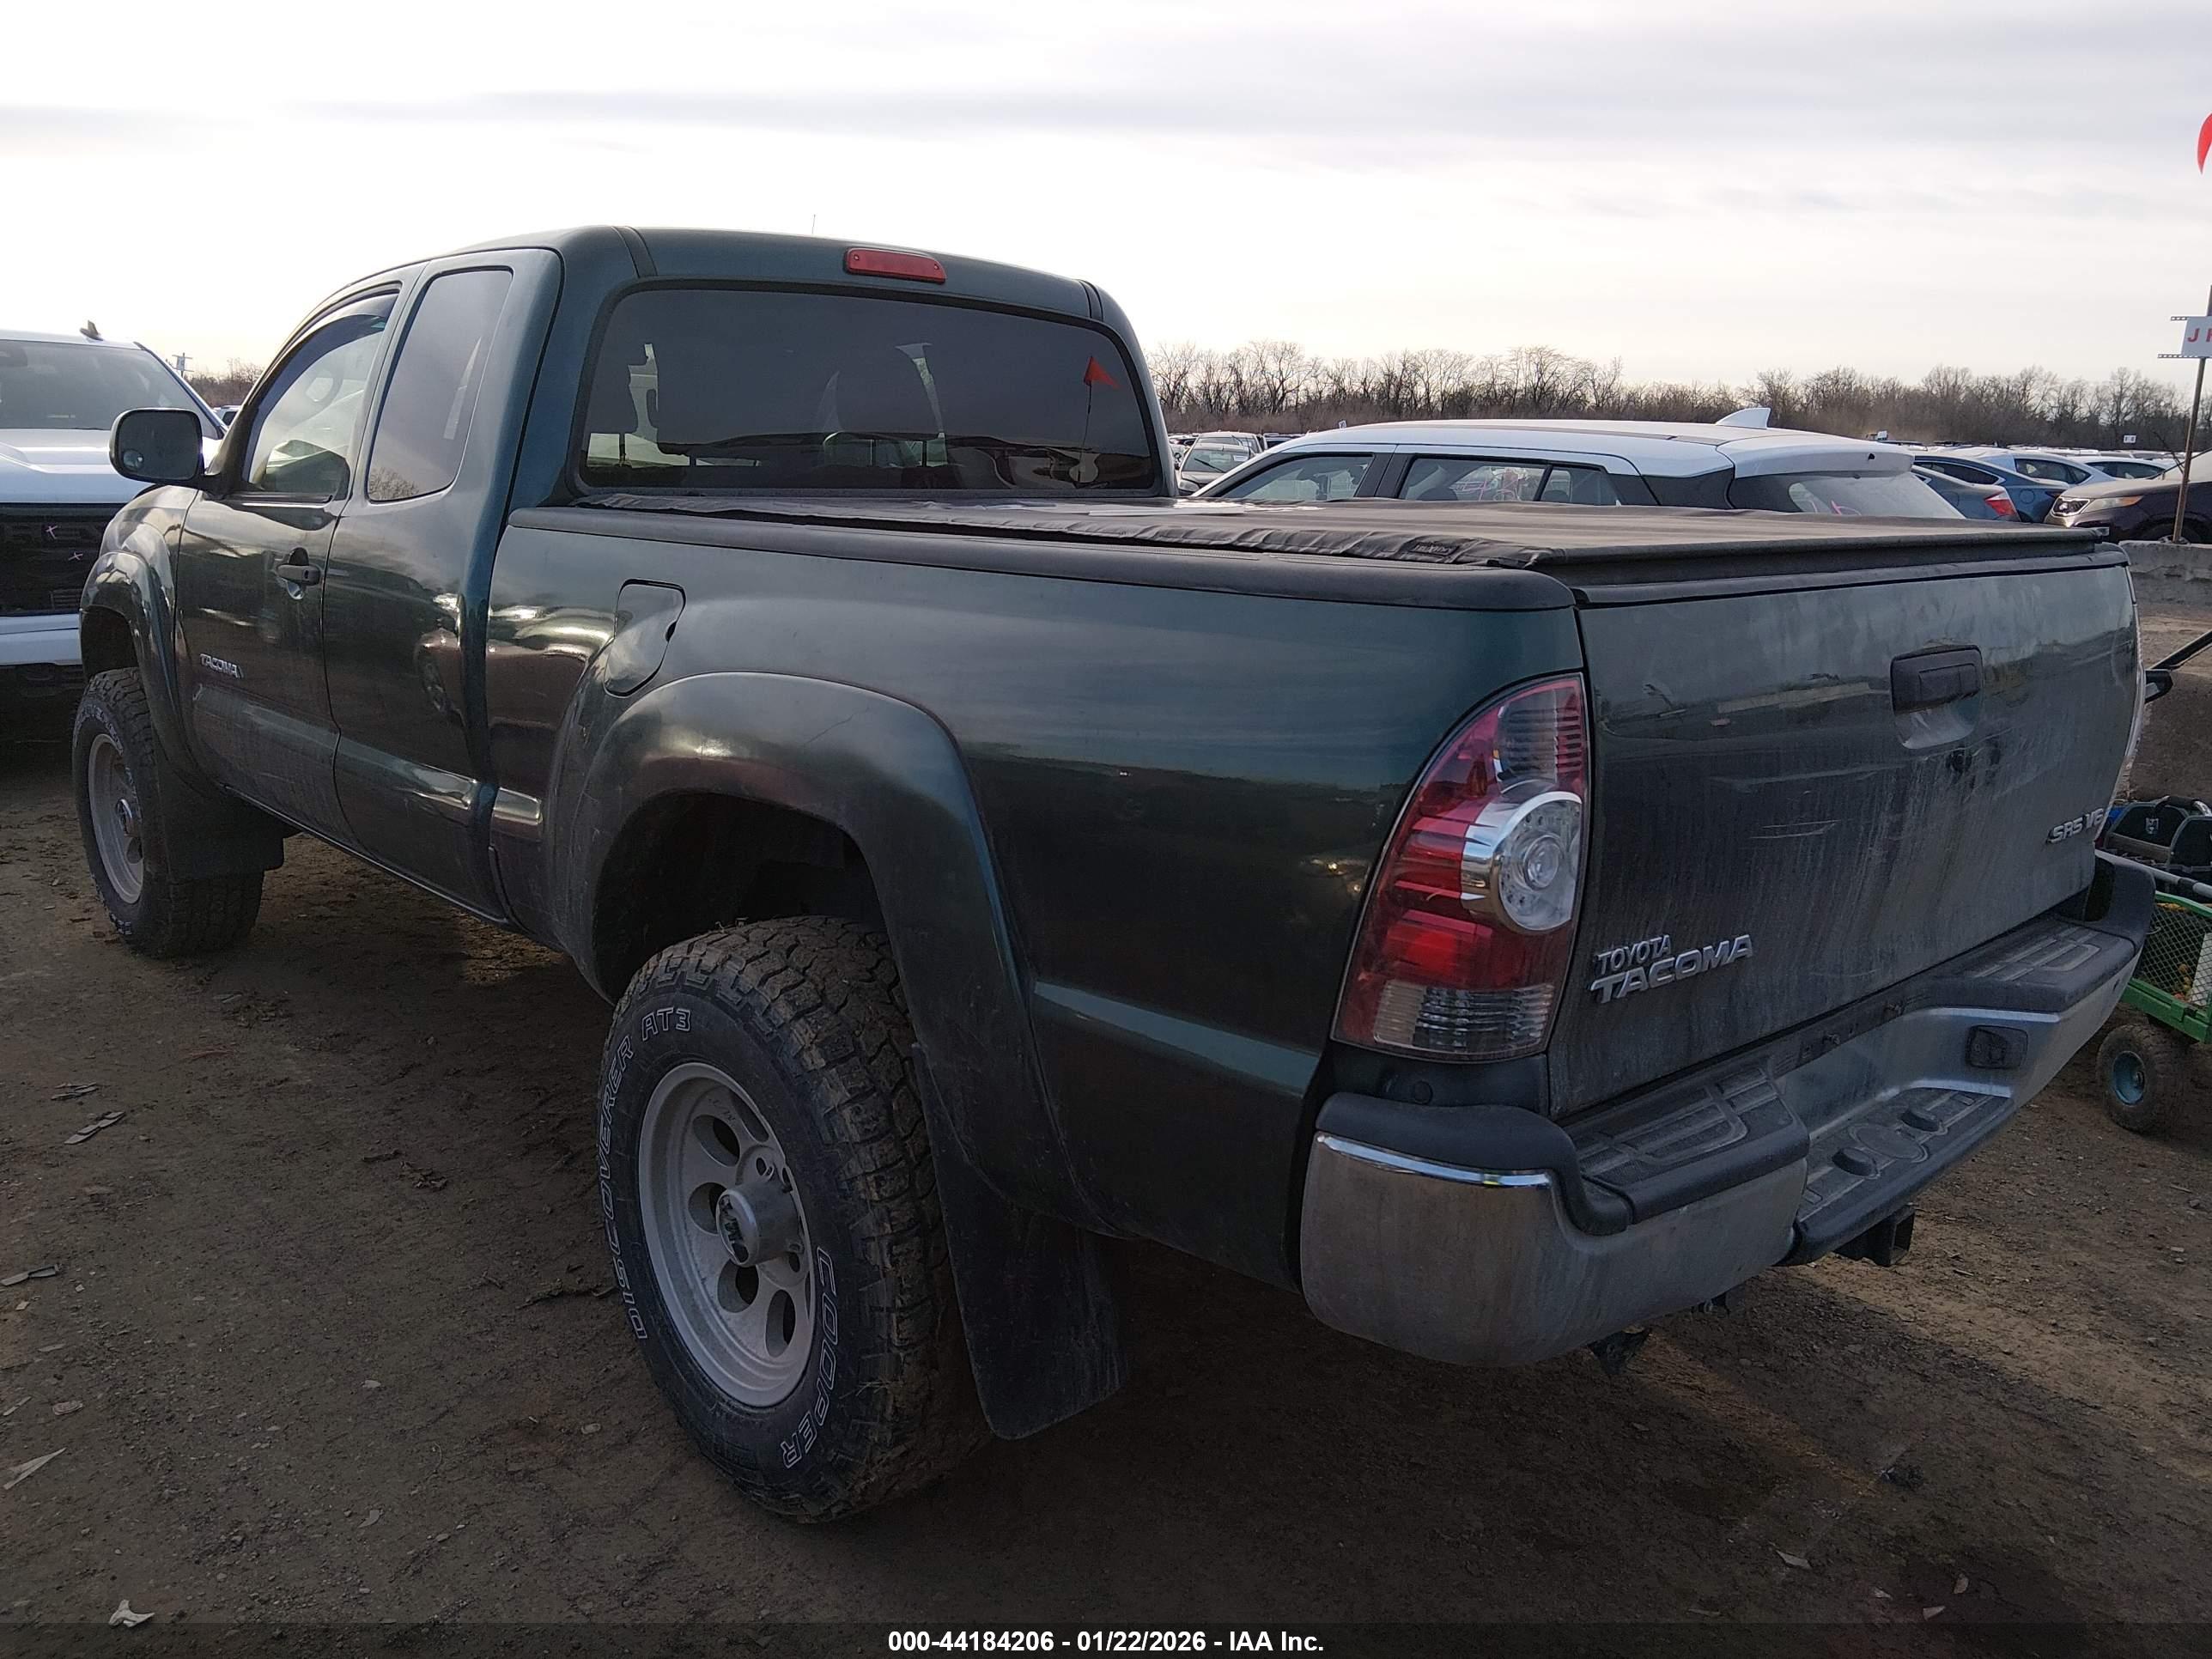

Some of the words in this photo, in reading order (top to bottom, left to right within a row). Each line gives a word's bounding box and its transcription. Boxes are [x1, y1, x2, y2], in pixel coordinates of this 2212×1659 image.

[199, 653, 241, 678] TACOMA
[2085, 808, 2105, 829] V6
[1589, 934, 1753, 1004] TACOMA
[1595, 934, 1672, 975] TOYOTA
[599, 1034, 647, 1340] DISCOVERER
[641, 1006, 692, 1042] AT3
[780, 1245, 839, 1469] COOPER
